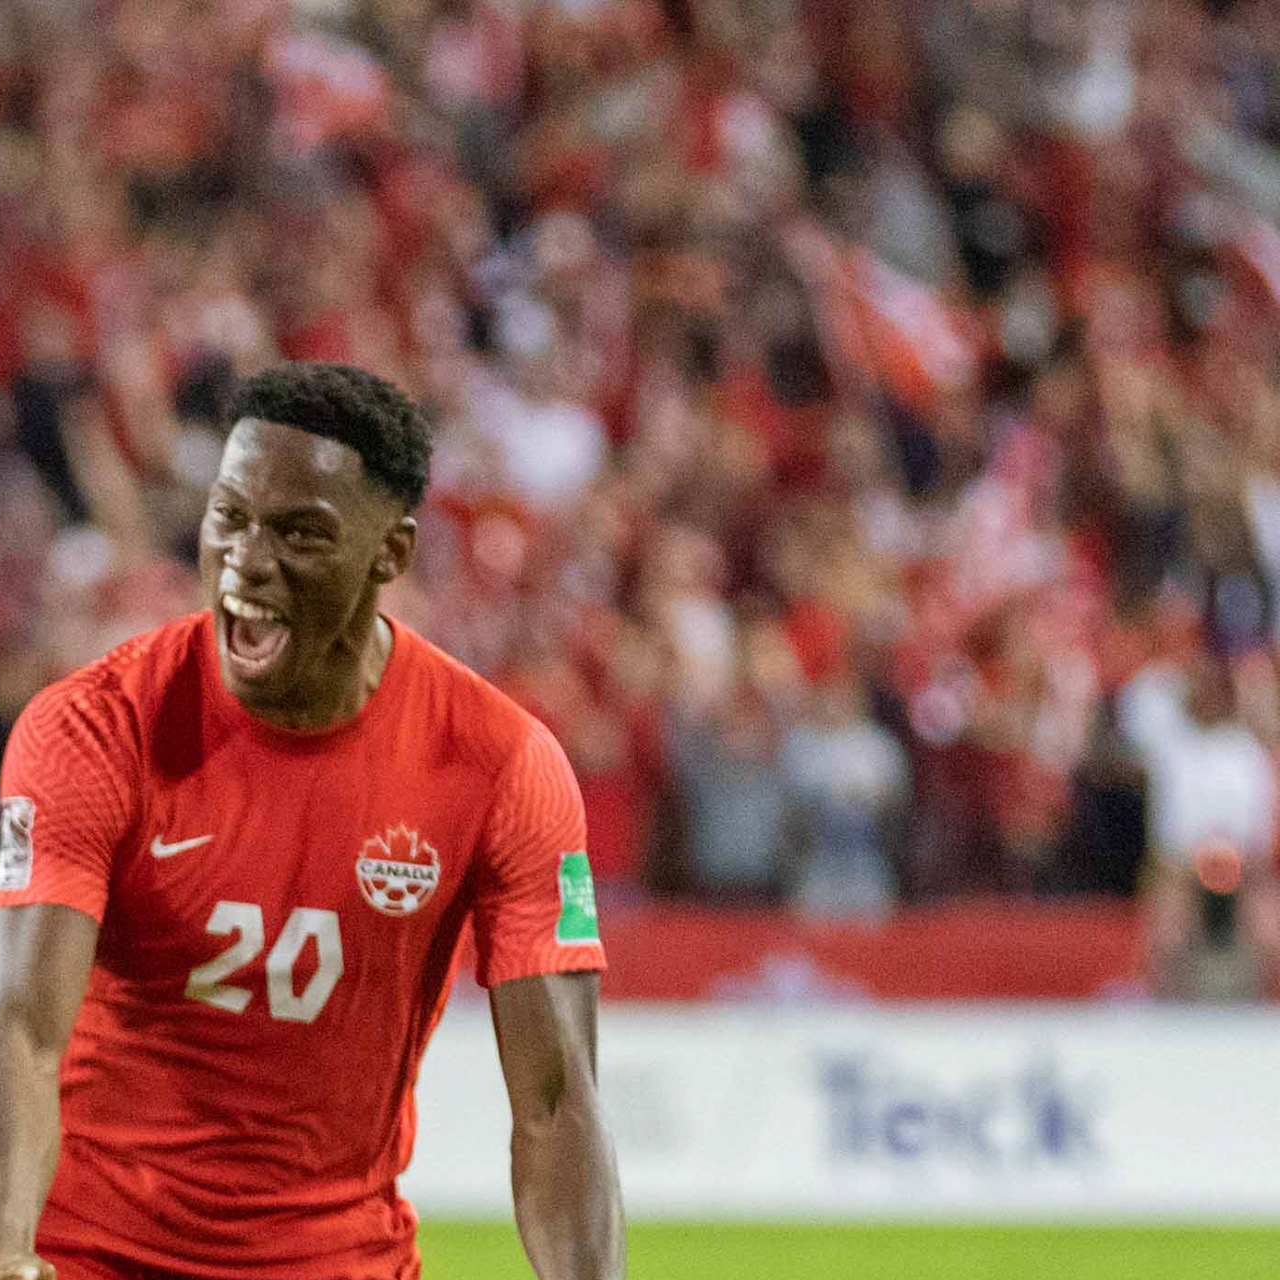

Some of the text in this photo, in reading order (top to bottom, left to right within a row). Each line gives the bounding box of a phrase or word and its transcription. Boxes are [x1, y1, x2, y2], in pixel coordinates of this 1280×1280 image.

[359, 861, 435, 881] CANADA
[184, 900, 344, 1025] 20
[814, 1044, 1104, 1160] Teck
